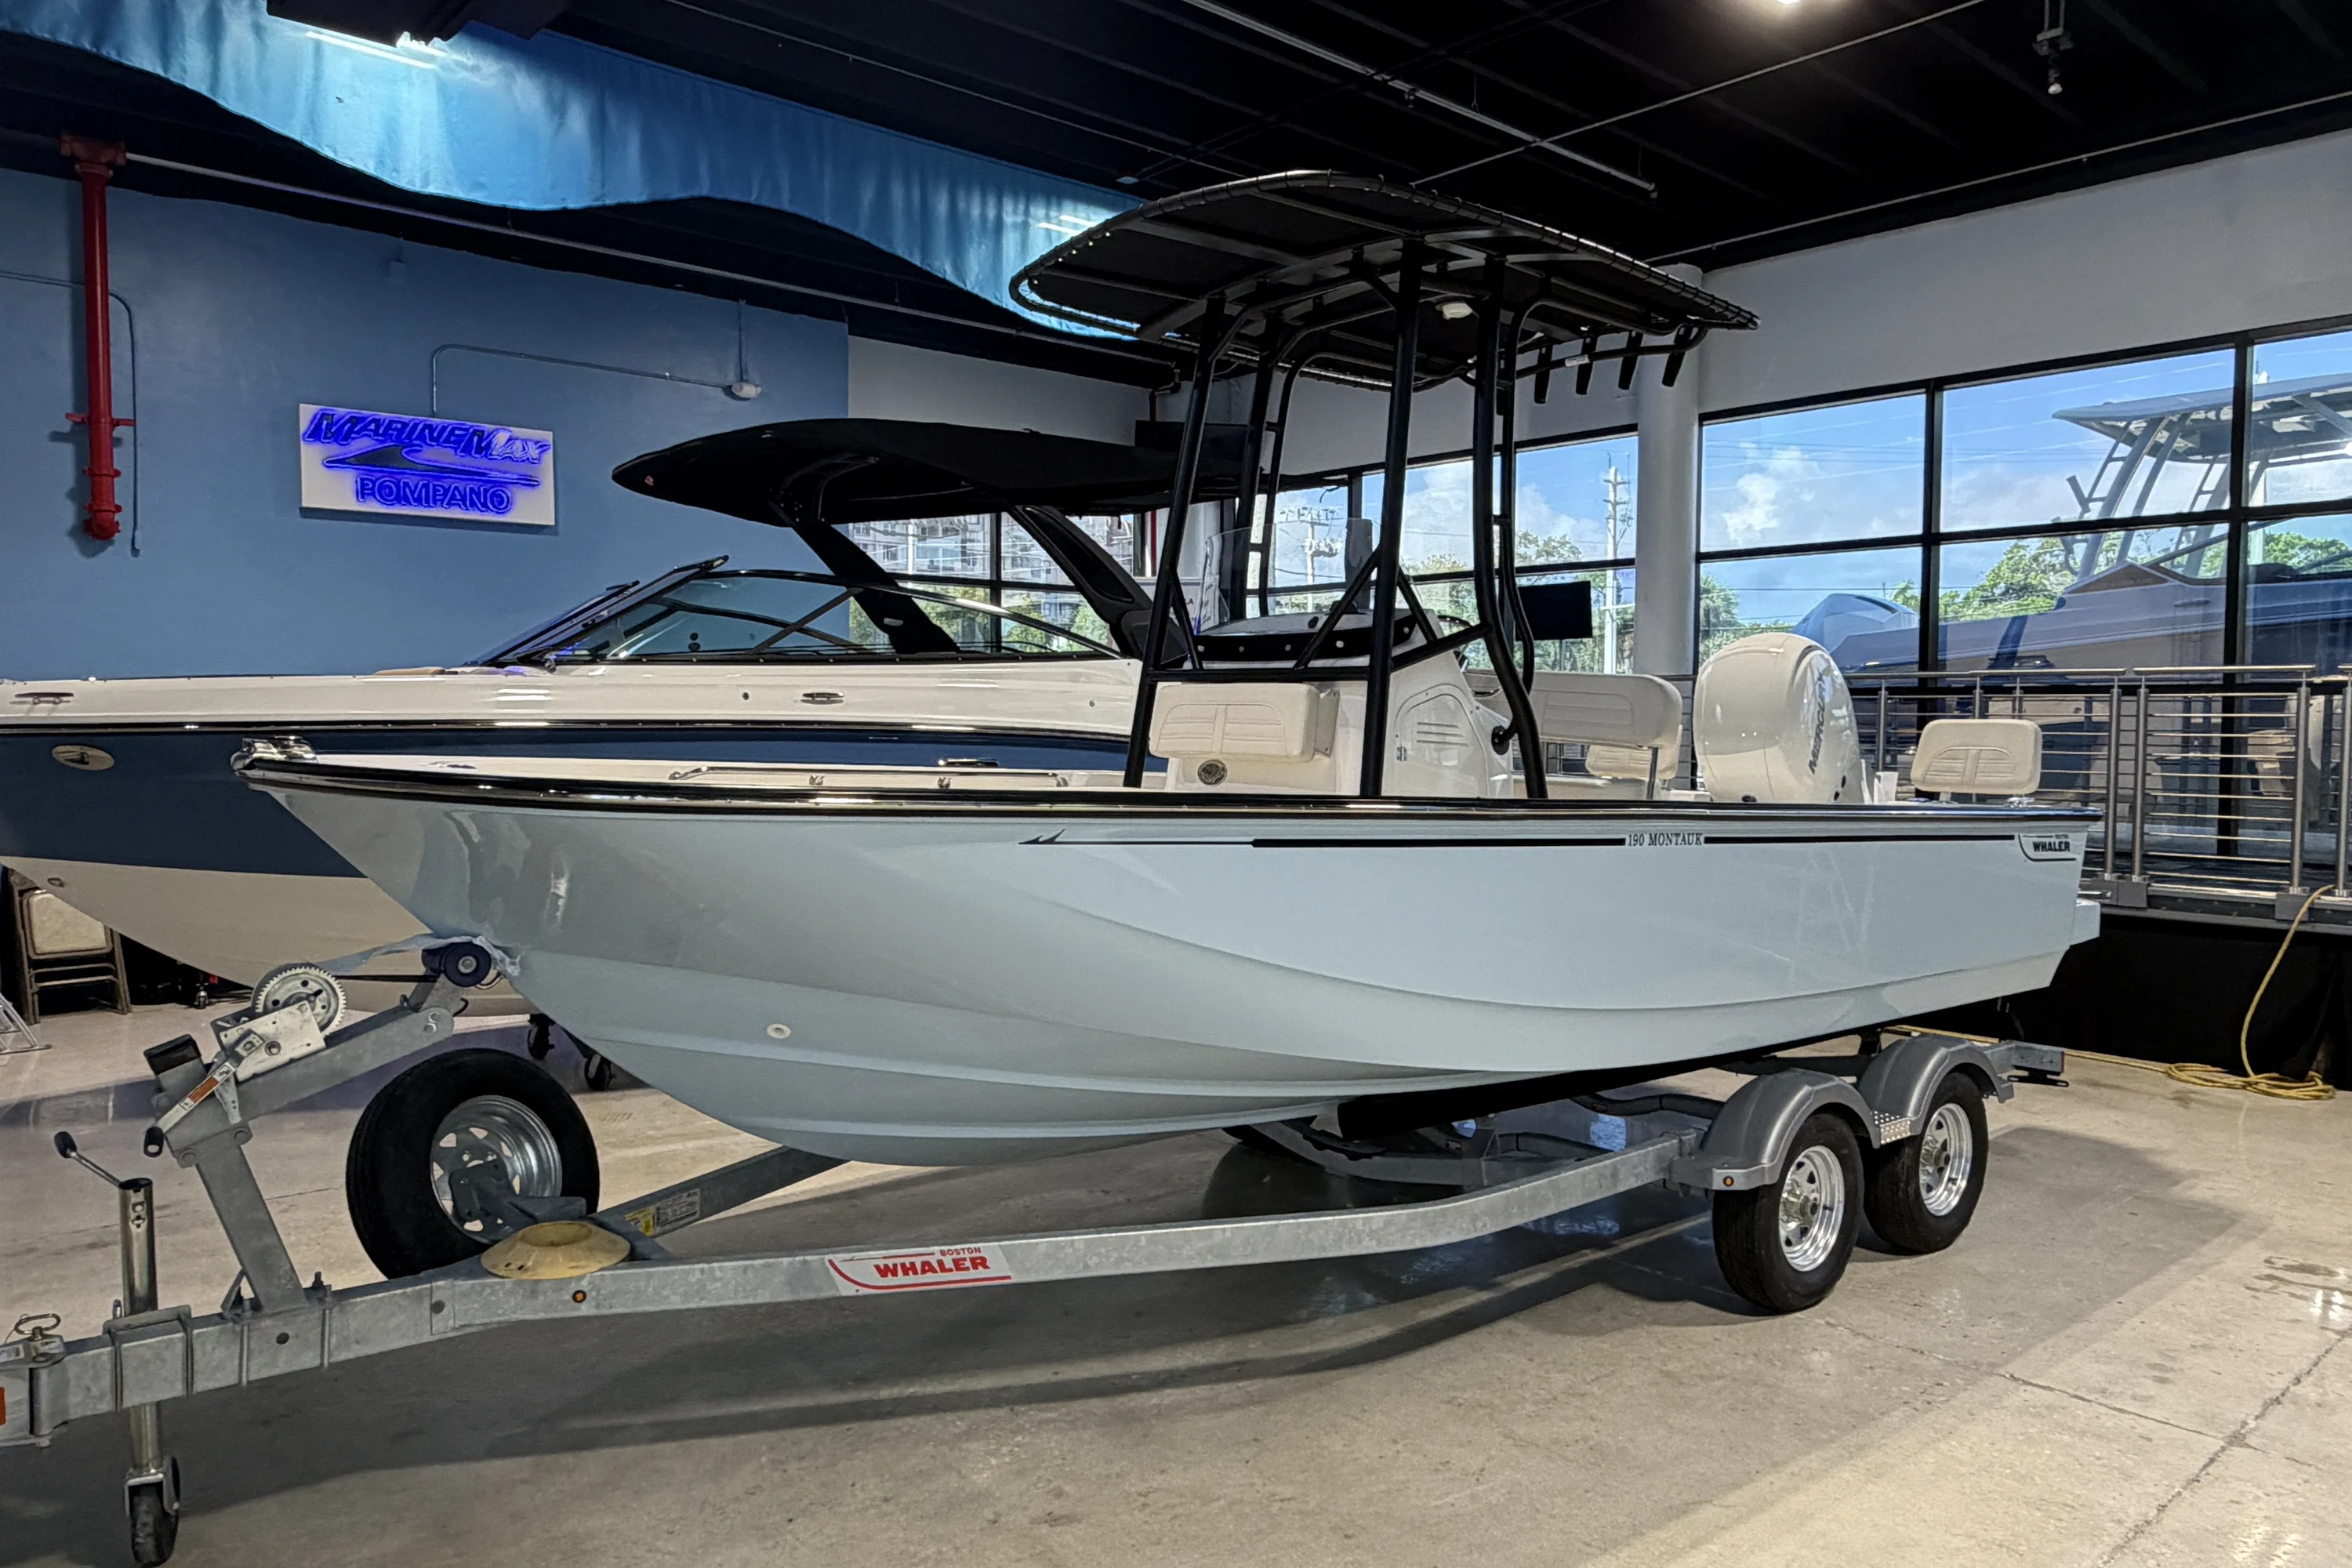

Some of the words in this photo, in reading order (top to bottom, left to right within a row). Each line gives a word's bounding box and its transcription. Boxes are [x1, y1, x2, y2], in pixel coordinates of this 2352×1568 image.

[355, 475, 513, 514] POMPANO
[1628, 833, 1645, 847] 190
[1648, 833, 1703, 846] MONTAUK
[2032, 840, 2071, 852] WHALER
[939, 1247, 982, 1257] BOSTON
[873, 1256, 990, 1279] WHALER
